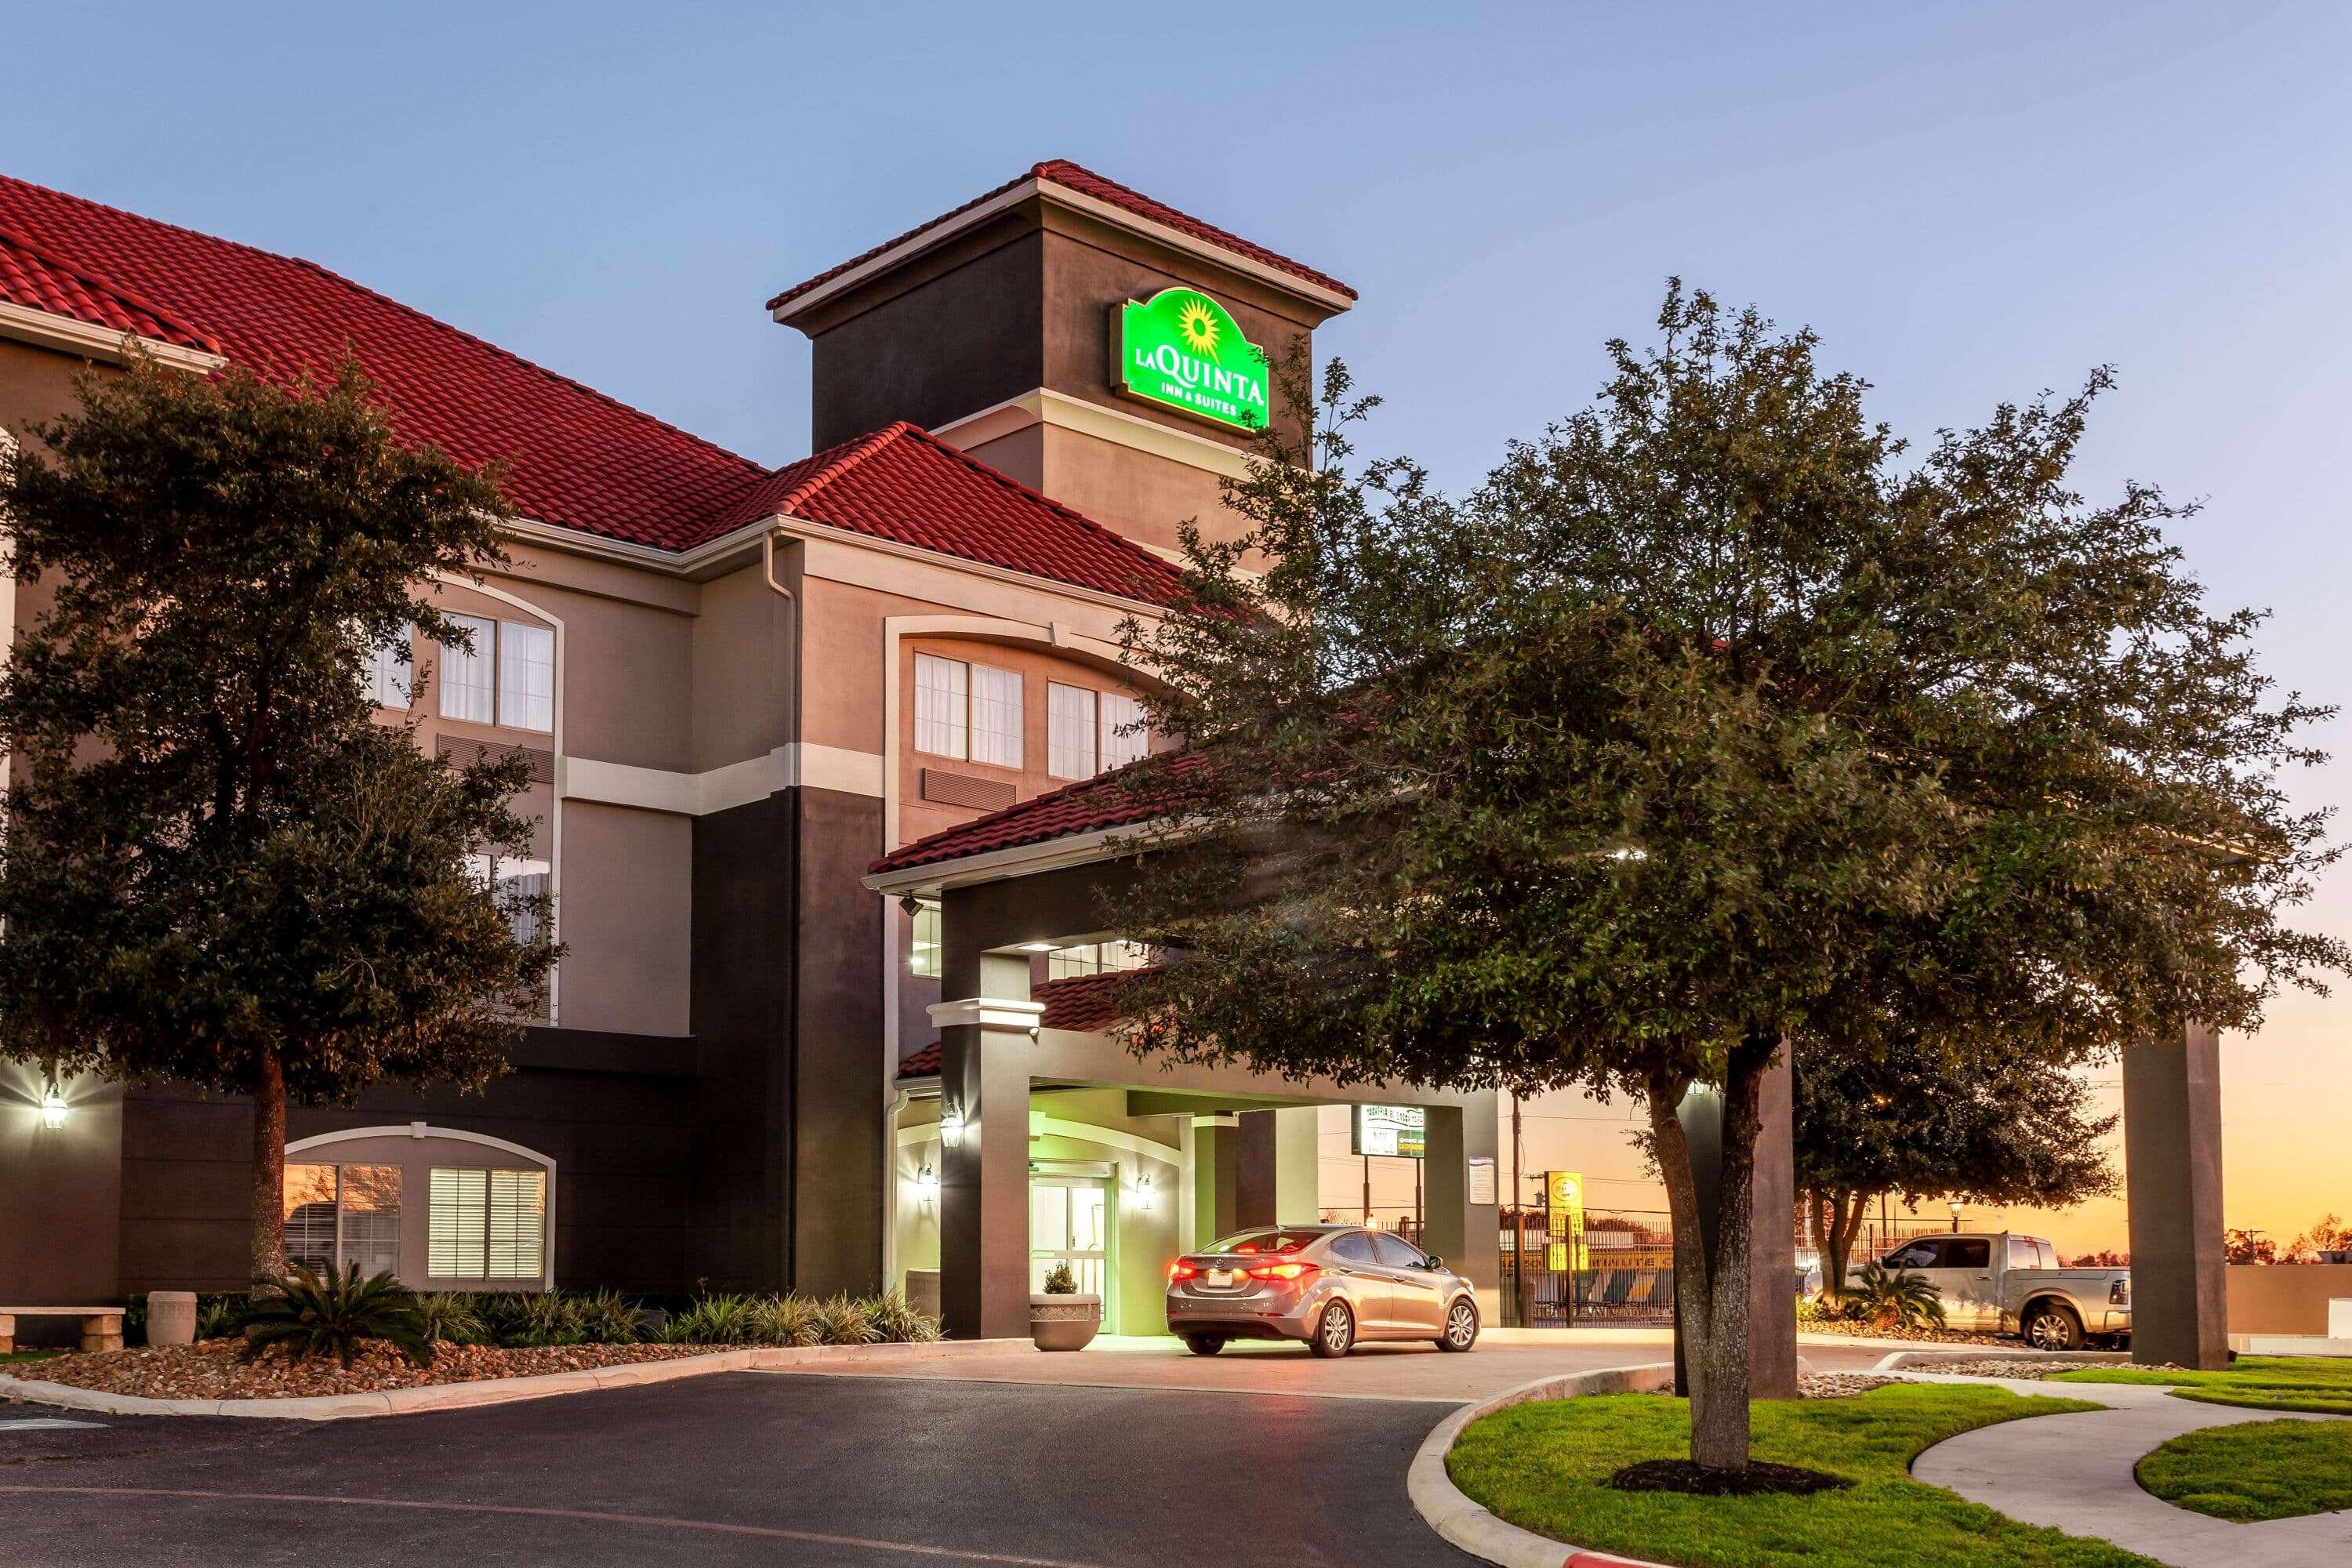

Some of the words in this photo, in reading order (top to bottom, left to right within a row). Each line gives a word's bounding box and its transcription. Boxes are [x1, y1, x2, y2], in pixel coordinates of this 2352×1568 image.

[1156, 344, 1264, 406] QUINTA
[1161, 381, 1183, 399] INN
[1185, 390, 1192, 401] &
[1195, 393, 1236, 416] SUITES
